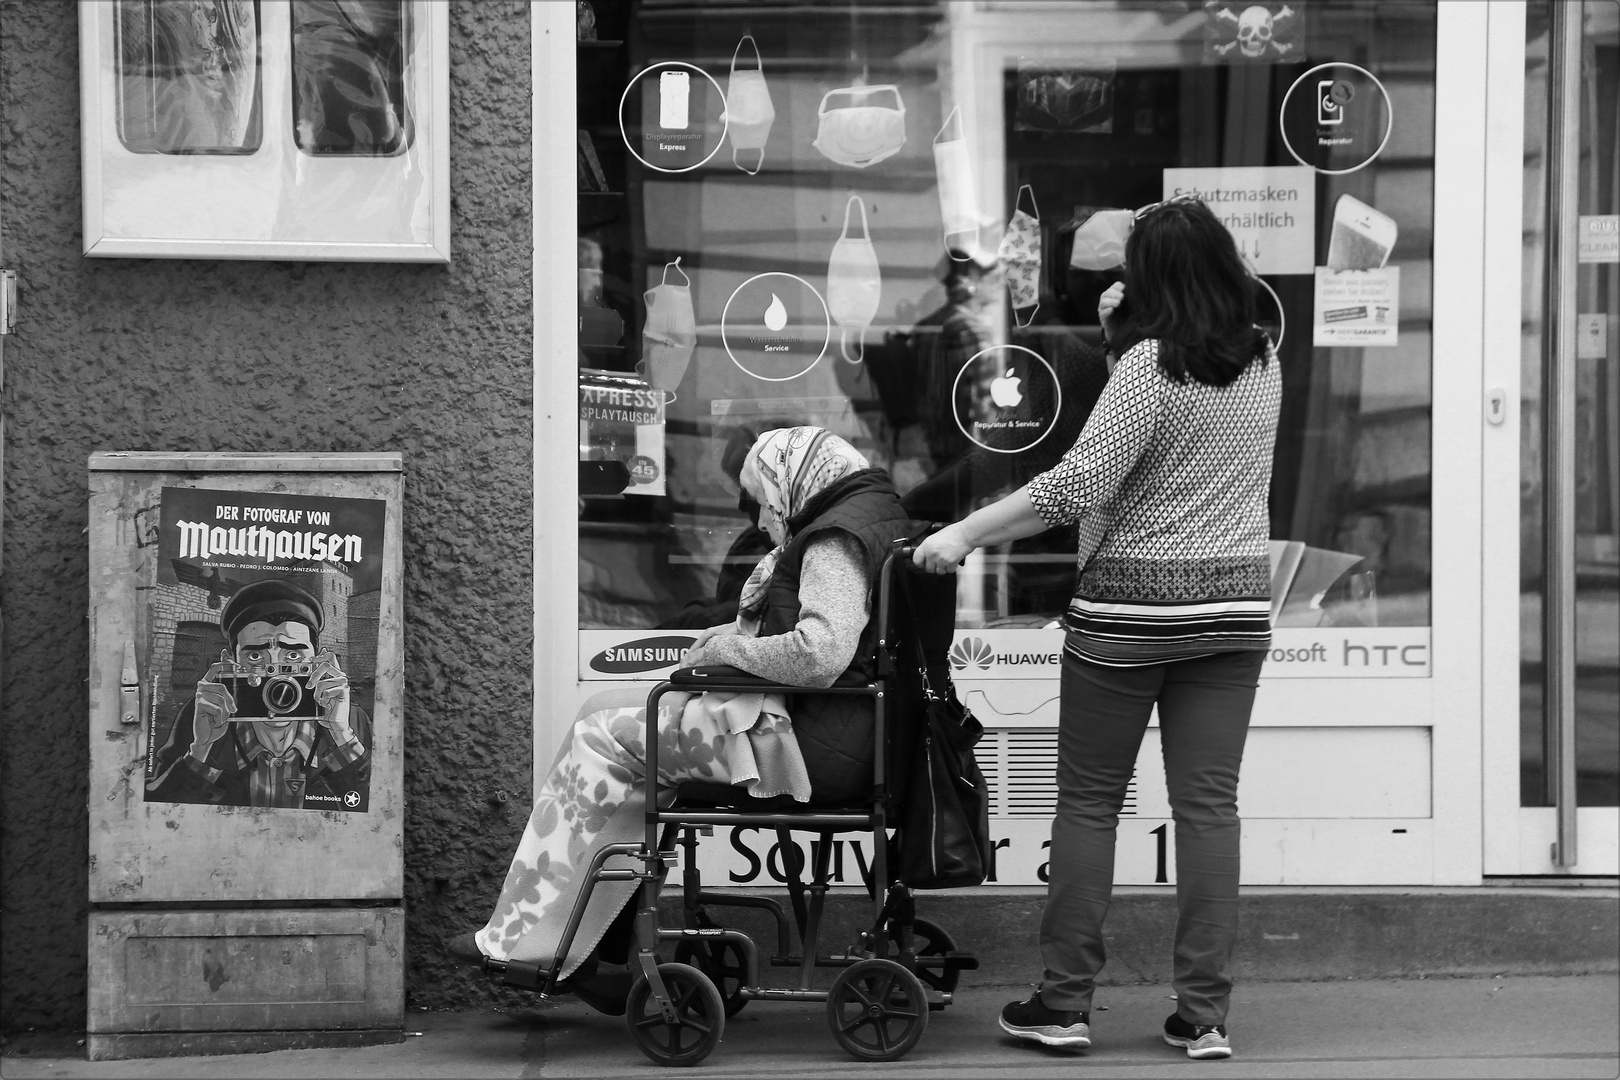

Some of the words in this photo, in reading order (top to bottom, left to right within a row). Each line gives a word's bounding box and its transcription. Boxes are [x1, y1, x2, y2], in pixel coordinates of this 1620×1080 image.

[659, 143, 686, 151] Express
[764, 344, 789, 352] Service
[631, 465, 654, 475] 45
[216, 505, 239, 521] DER
[243, 507, 303, 524] FOTOGRAF
[307, 511, 331, 526] VON
[175, 519, 363, 563] Mauthausen
